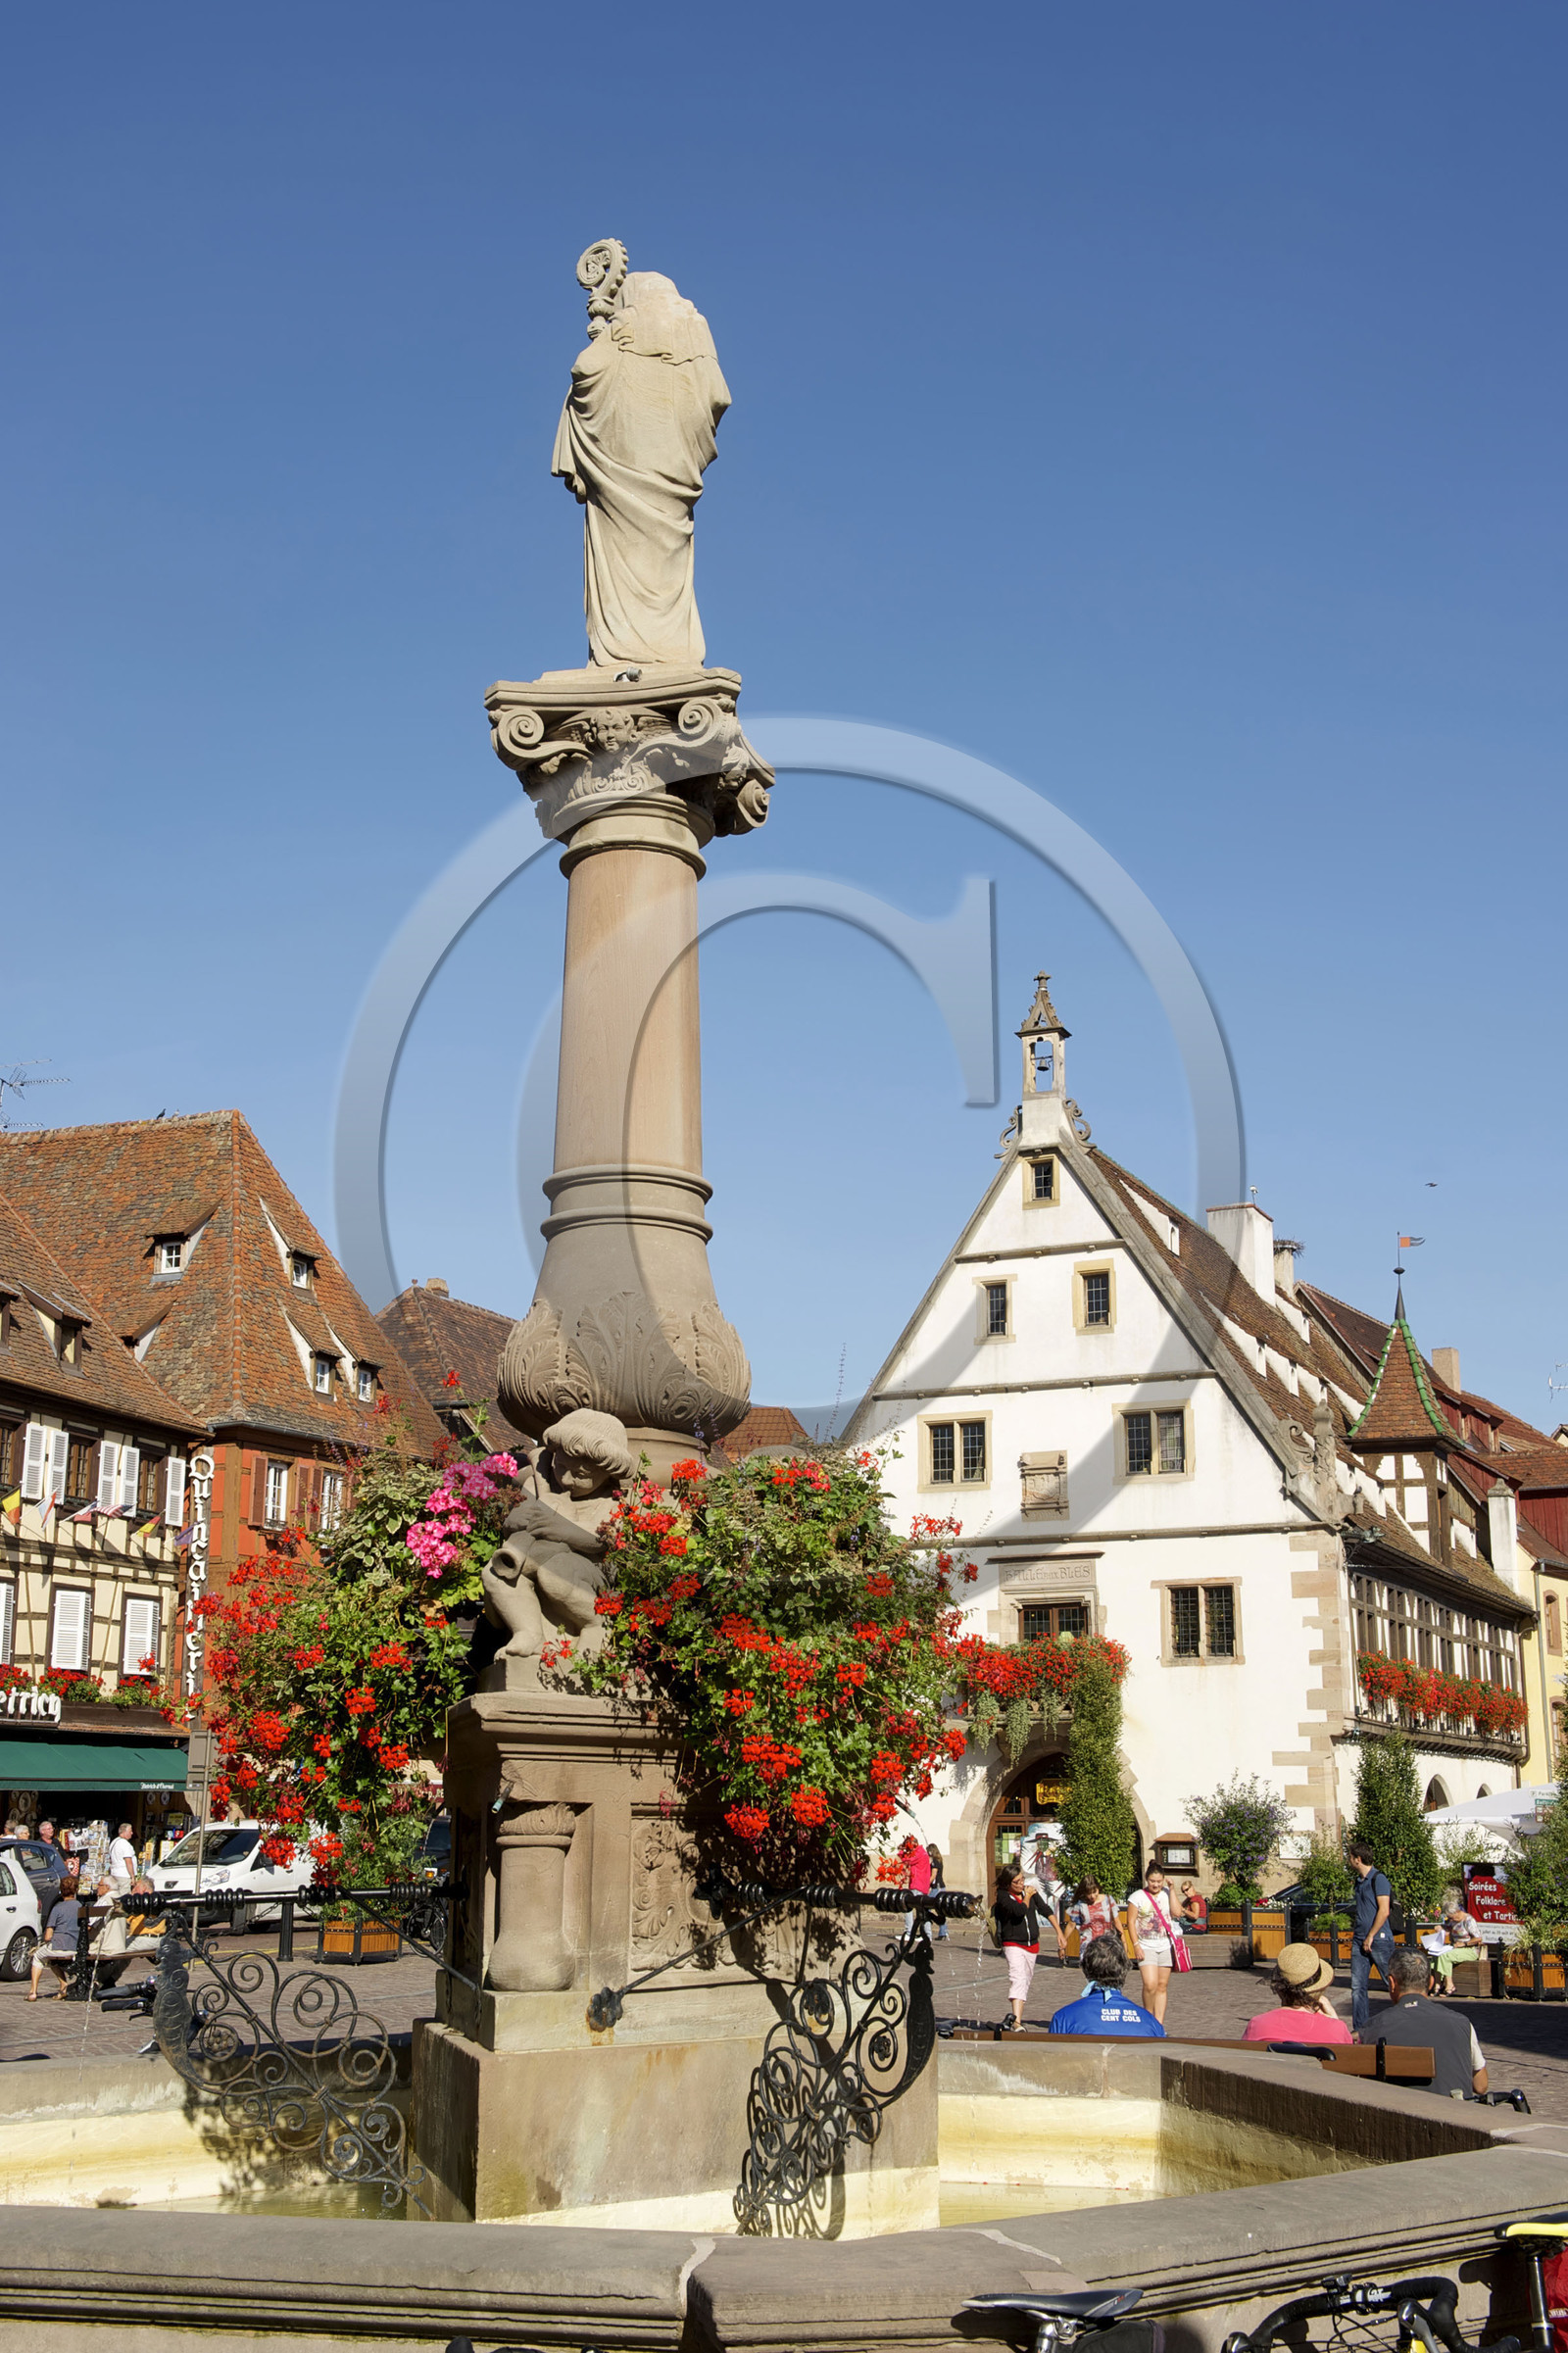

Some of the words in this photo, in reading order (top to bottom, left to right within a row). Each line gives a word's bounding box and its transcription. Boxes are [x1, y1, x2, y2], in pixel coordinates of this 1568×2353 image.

[1468, 1882, 1497, 1891] Soirées
[1475, 1895, 1506, 1905] Folklore
[1483, 1911, 1492, 1920] et
